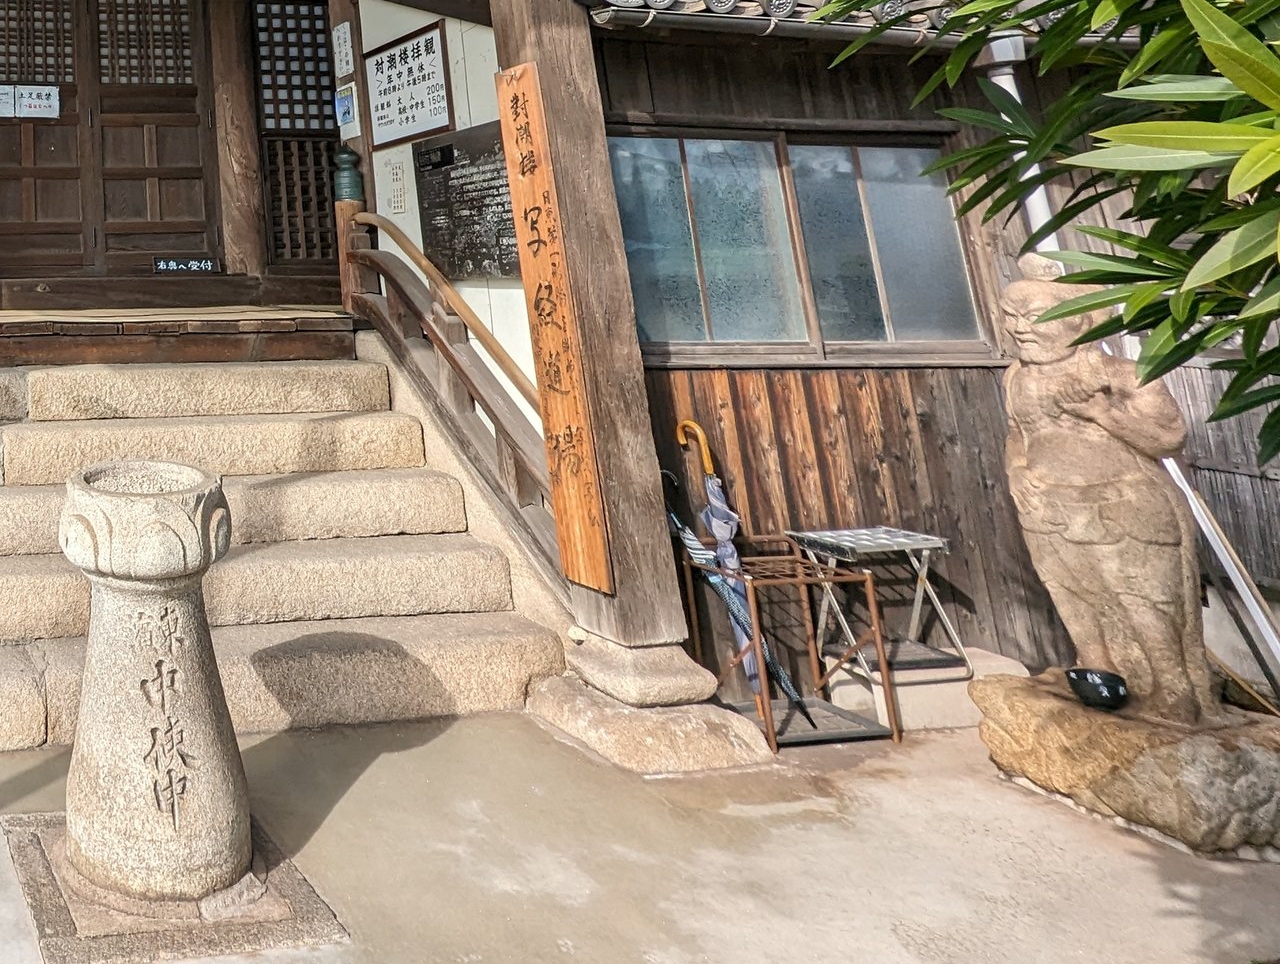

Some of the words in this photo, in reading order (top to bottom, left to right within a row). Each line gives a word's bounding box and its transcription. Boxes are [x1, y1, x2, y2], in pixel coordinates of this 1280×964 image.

[157, 259, 213, 271] 右奥へ受付
